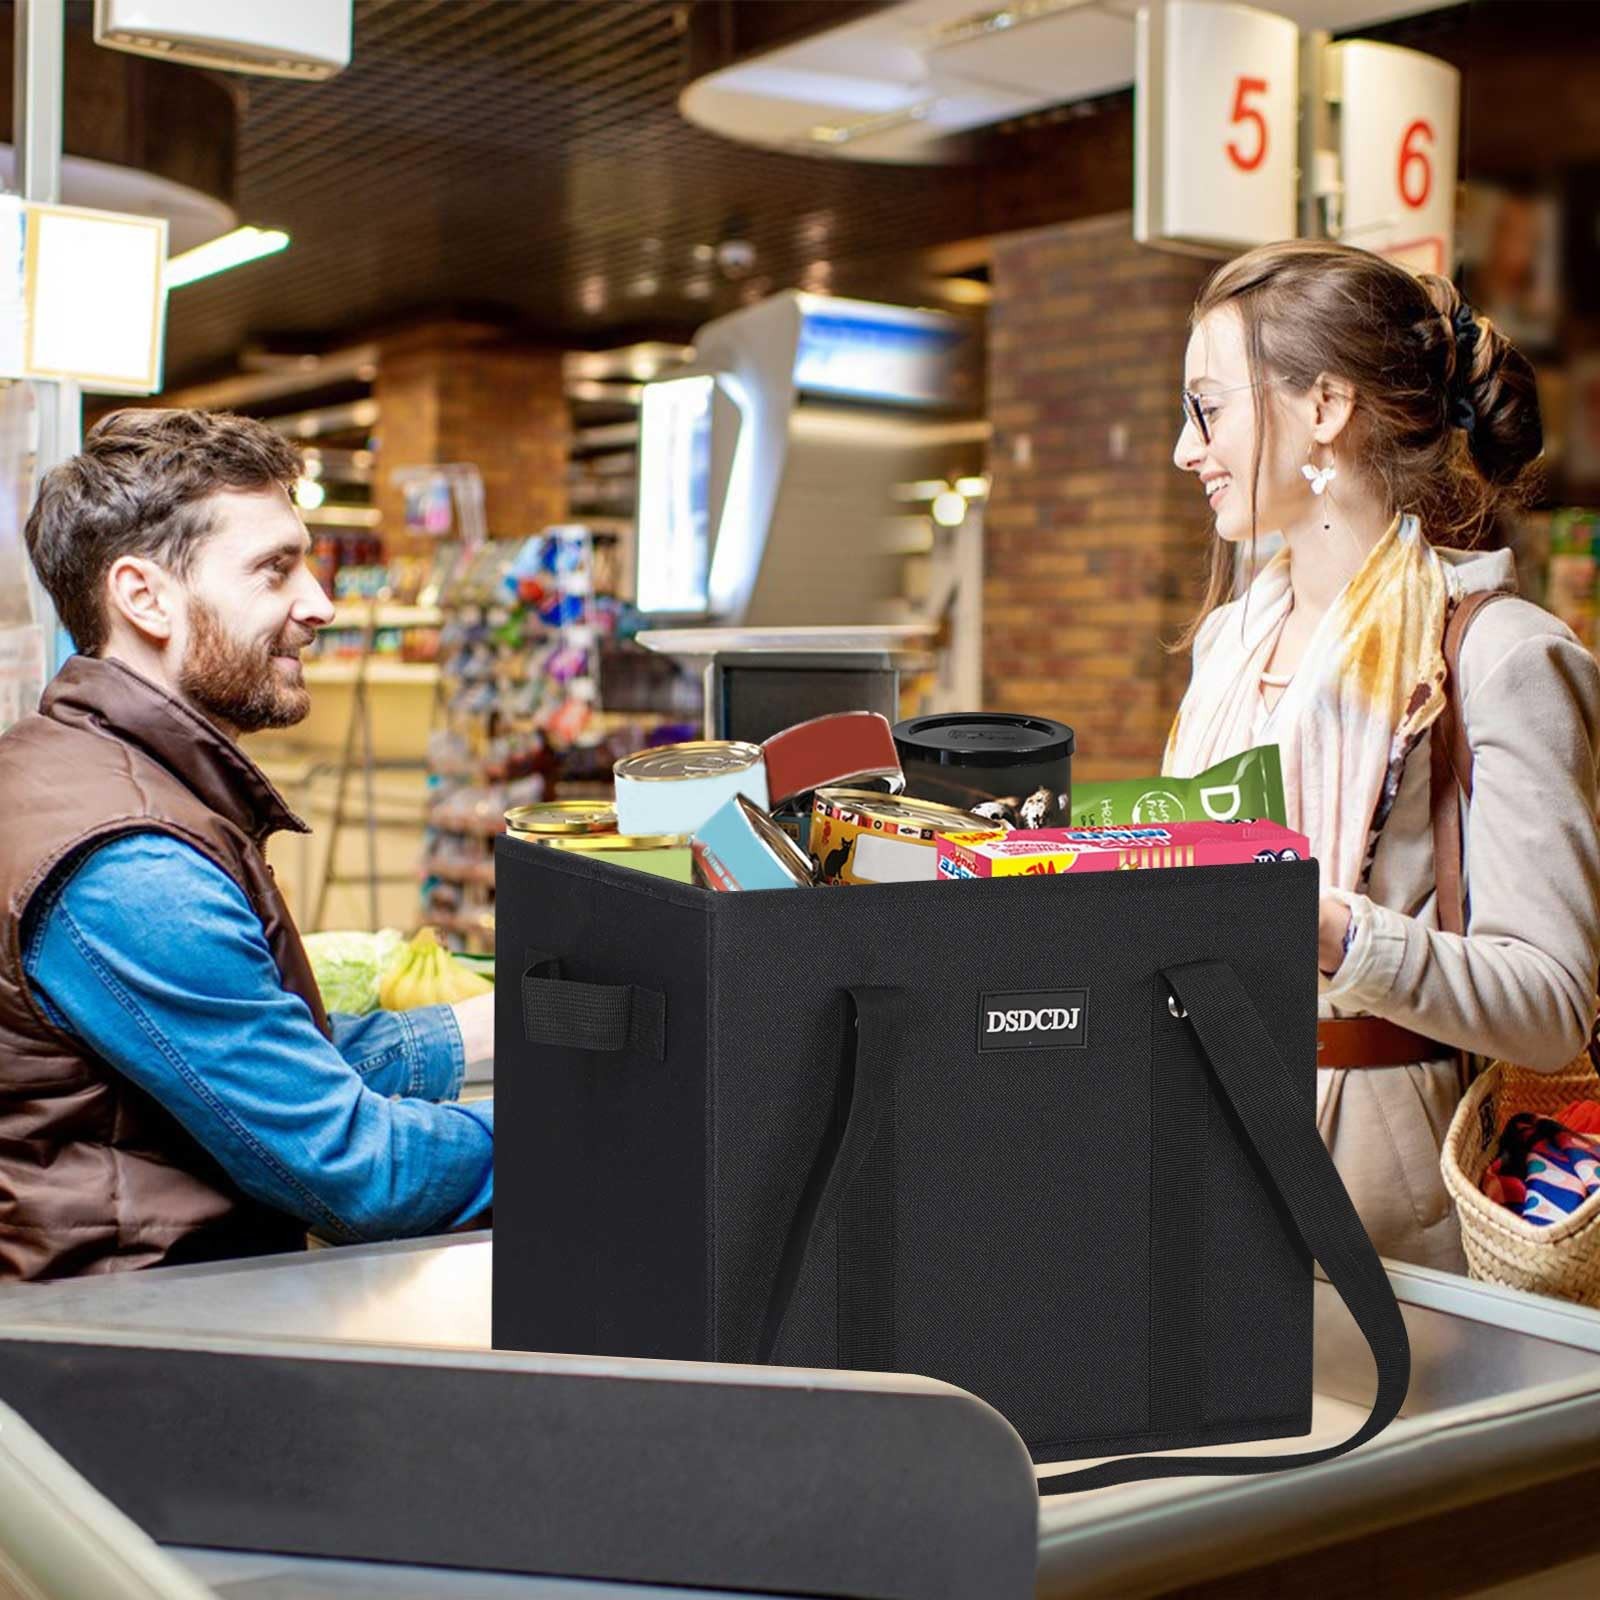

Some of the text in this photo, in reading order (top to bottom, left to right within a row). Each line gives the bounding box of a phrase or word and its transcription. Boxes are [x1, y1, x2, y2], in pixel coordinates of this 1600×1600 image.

[1226, 77, 1267, 171] 5
[1397, 120, 1434, 209] 6
[986, 1007, 1081, 1033] DSDCDJ
